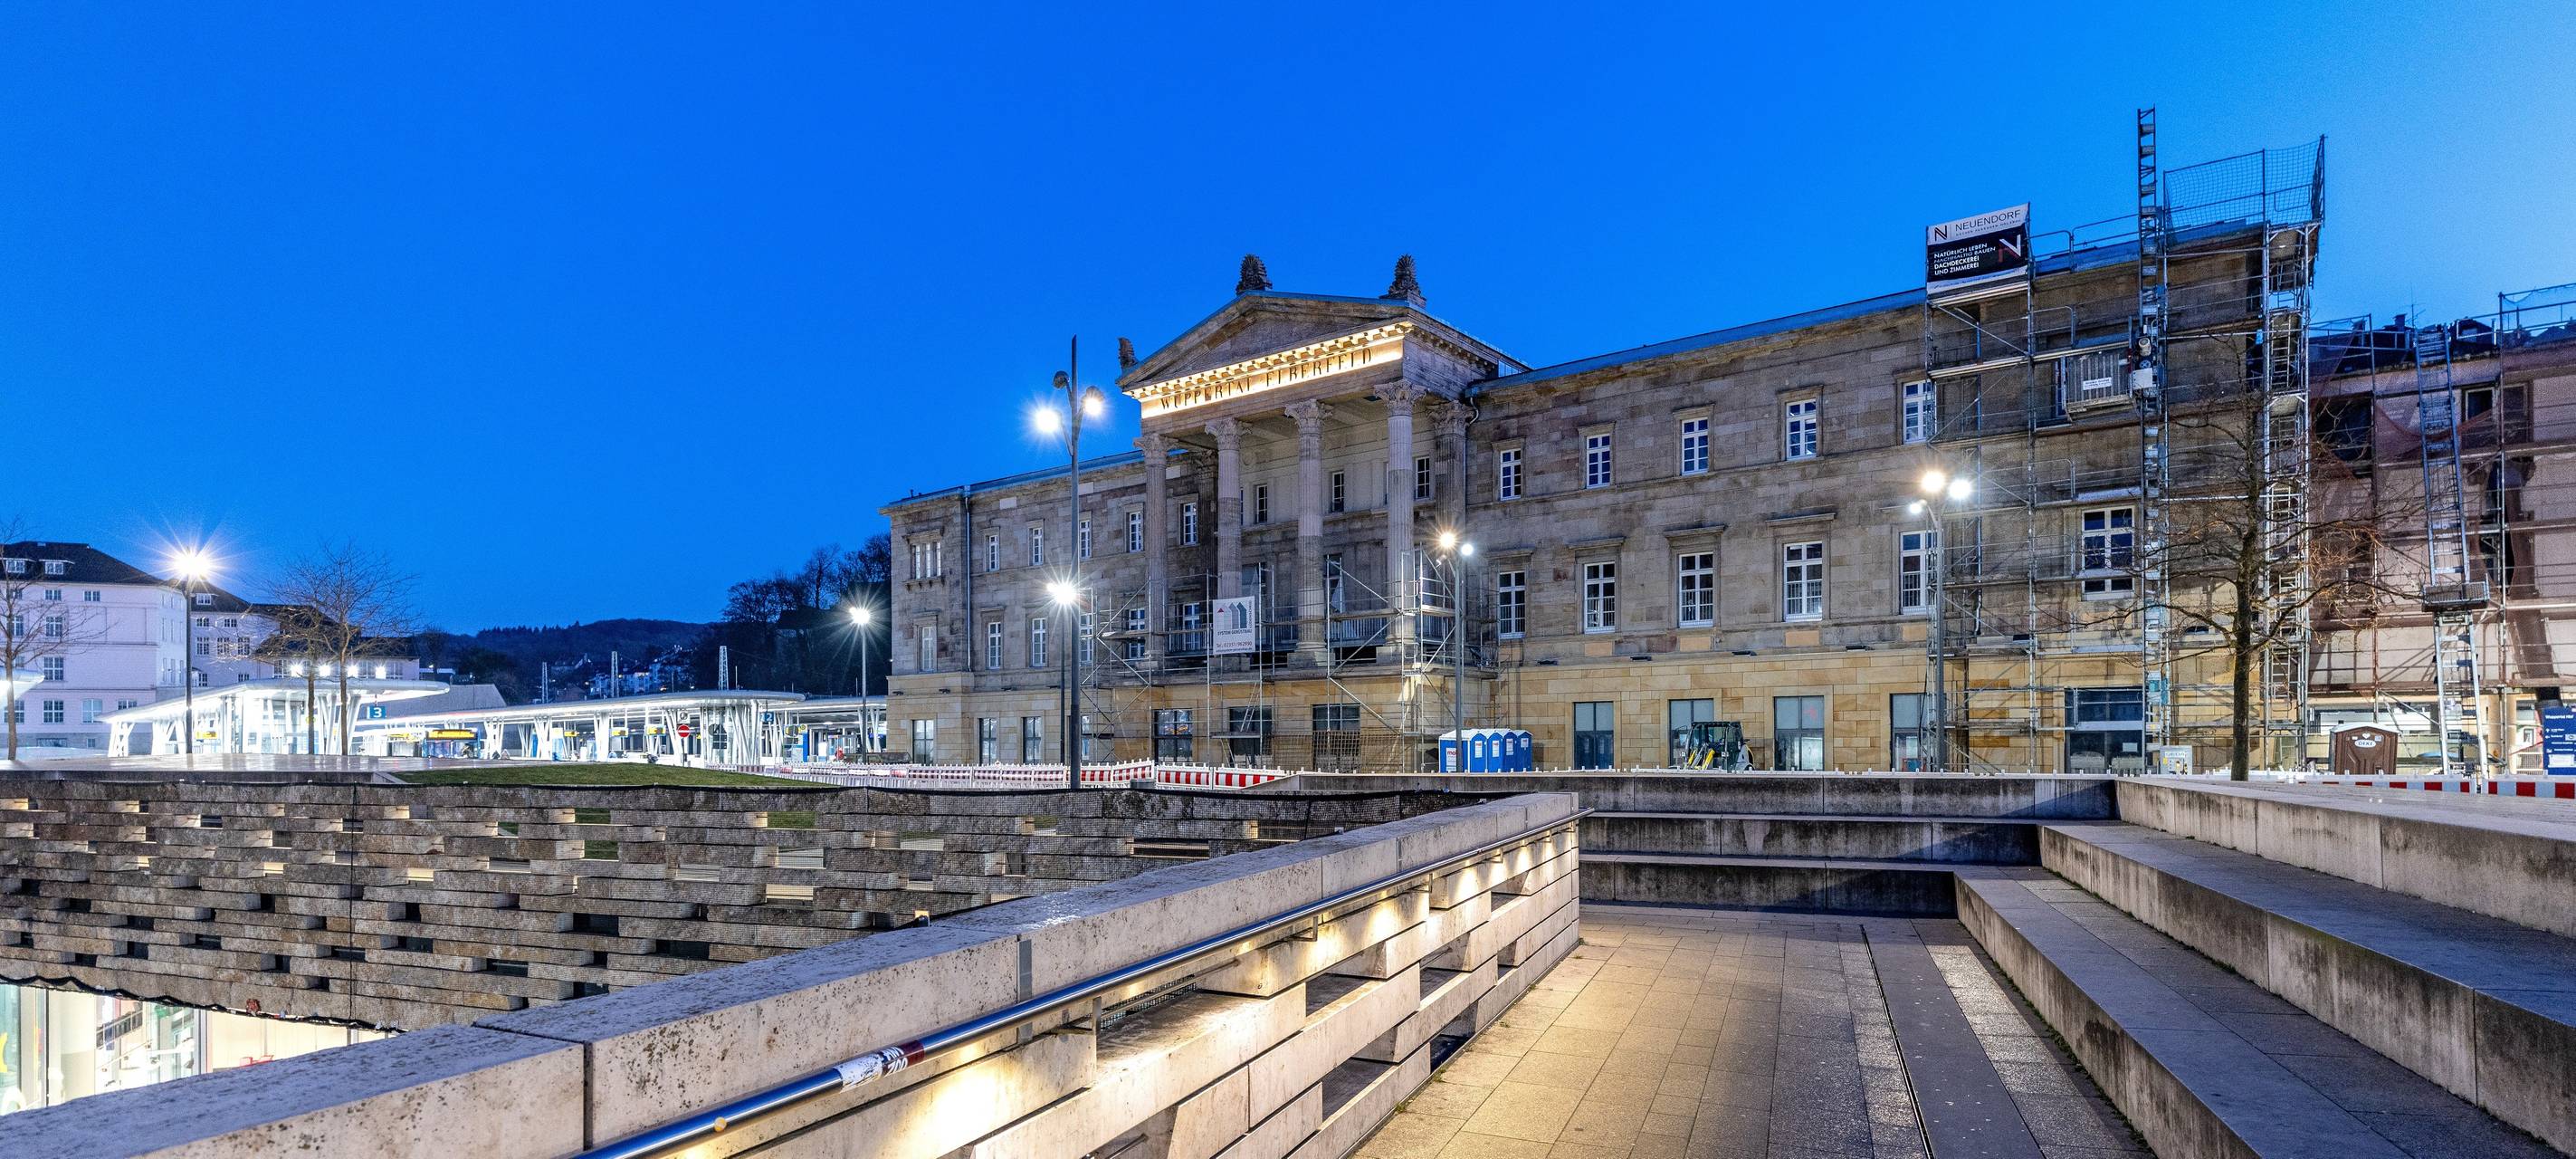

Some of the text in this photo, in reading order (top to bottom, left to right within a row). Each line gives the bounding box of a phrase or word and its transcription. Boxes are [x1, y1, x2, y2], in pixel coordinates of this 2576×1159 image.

[1955, 209, 2021, 232] NEUENDORF
[1933, 243, 1988, 259] NATÜRLICH LEBEN
[1974, 246, 1996, 255] BAUEN
[1933, 255, 1980, 270] DACHDECKEREI
[1950, 262, 1980, 273] ZIMMEREI
[373, 707, 382, 718] 3
